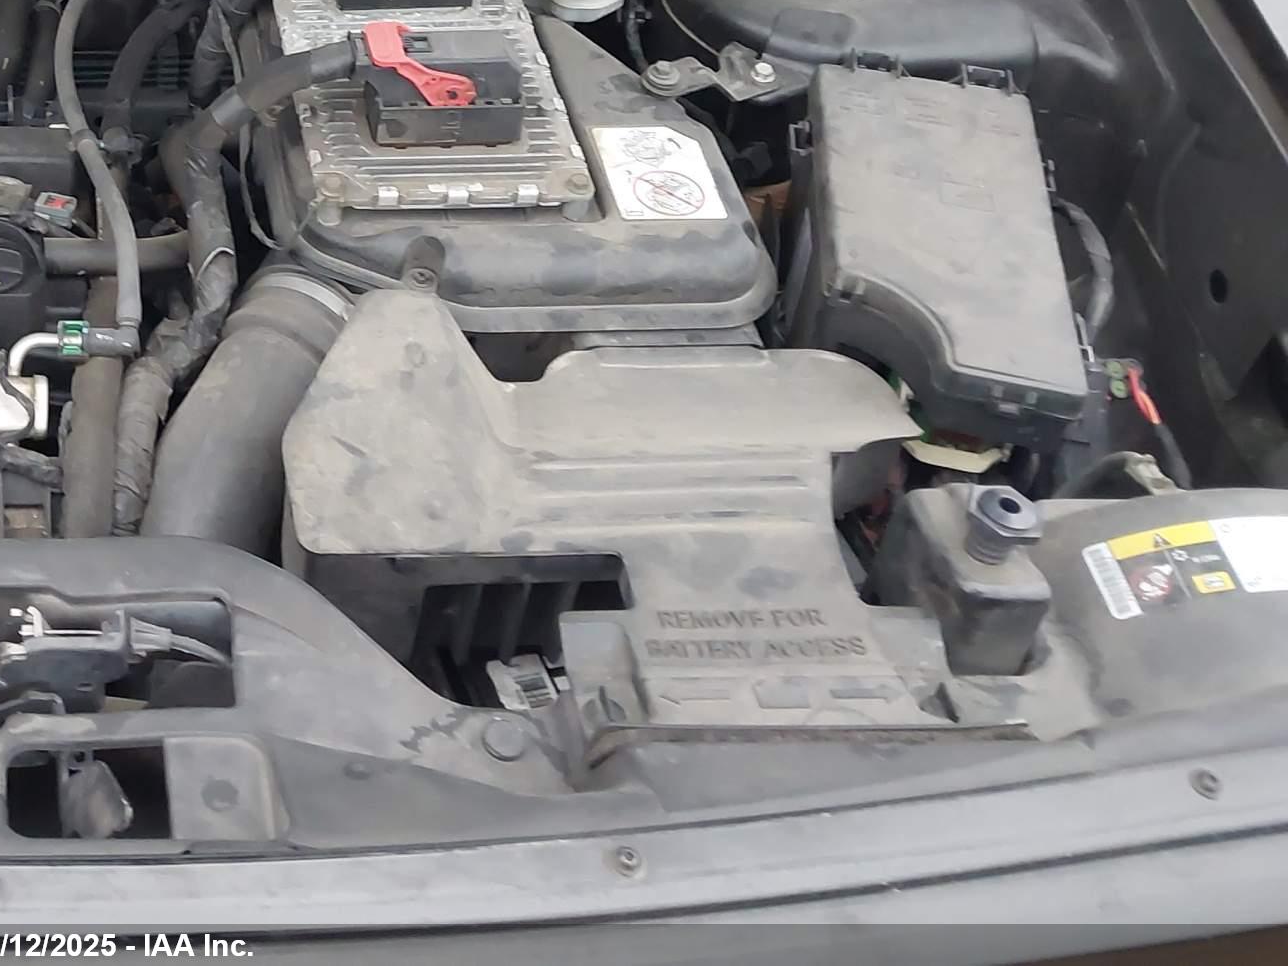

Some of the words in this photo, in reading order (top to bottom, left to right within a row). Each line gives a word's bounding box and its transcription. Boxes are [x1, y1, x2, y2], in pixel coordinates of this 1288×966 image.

[656, 610, 764, 630] REMOVE
[769, 609, 829, 627] FOR
[644, 638, 753, 659] BATTERY
[763, 636, 869, 658] ACCESS
